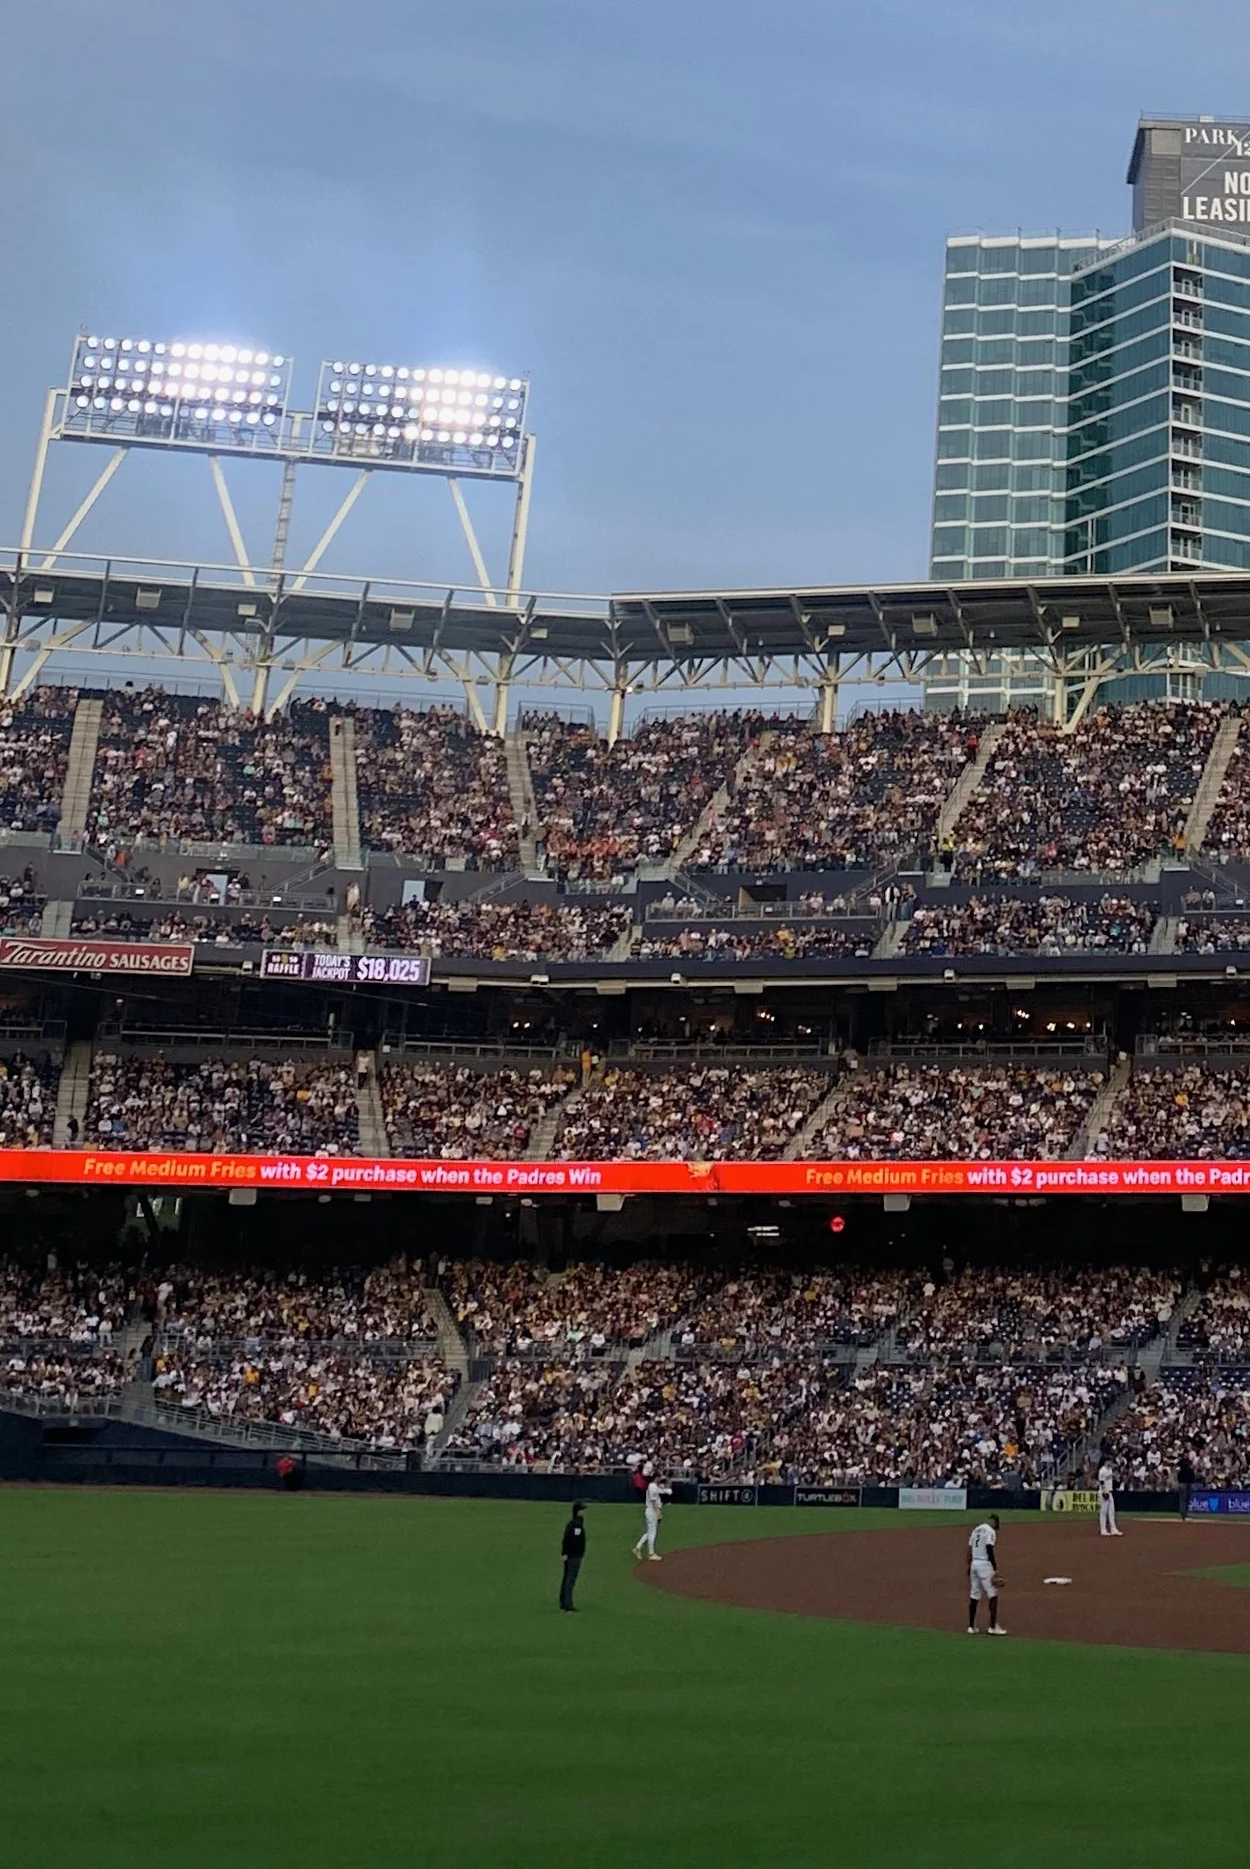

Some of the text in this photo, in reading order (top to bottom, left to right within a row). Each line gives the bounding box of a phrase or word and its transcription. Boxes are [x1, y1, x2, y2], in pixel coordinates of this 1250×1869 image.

[1184, 127, 1240, 145] PARK
[1, 941, 188, 971] Tarantino SAUSAGES
[314, 955, 350, 967] TODAY'S
[267, 963, 299, 974] RAFFLE
[312, 966, 350, 980] JACKPOT
[357, 957, 421, 981] $18,025
[83, 1158, 601, 1185] Free Medium Fries with $2 purchase when the Padres Win
[806, 1169, 843, 1185] Free
[847, 1168, 917, 1185] Medium
[921, 1168, 964, 1185] Fries
[968, 1168, 1006, 1185] with
[1010, 1168, 1032, 1186] $2
[1036, 1168, 1118, 1190] purchase
[1122, 1168, 1171, 1185] when
[1175, 1168, 1205, 1185] the
[1228, 1498, 1250, 1510] blue
